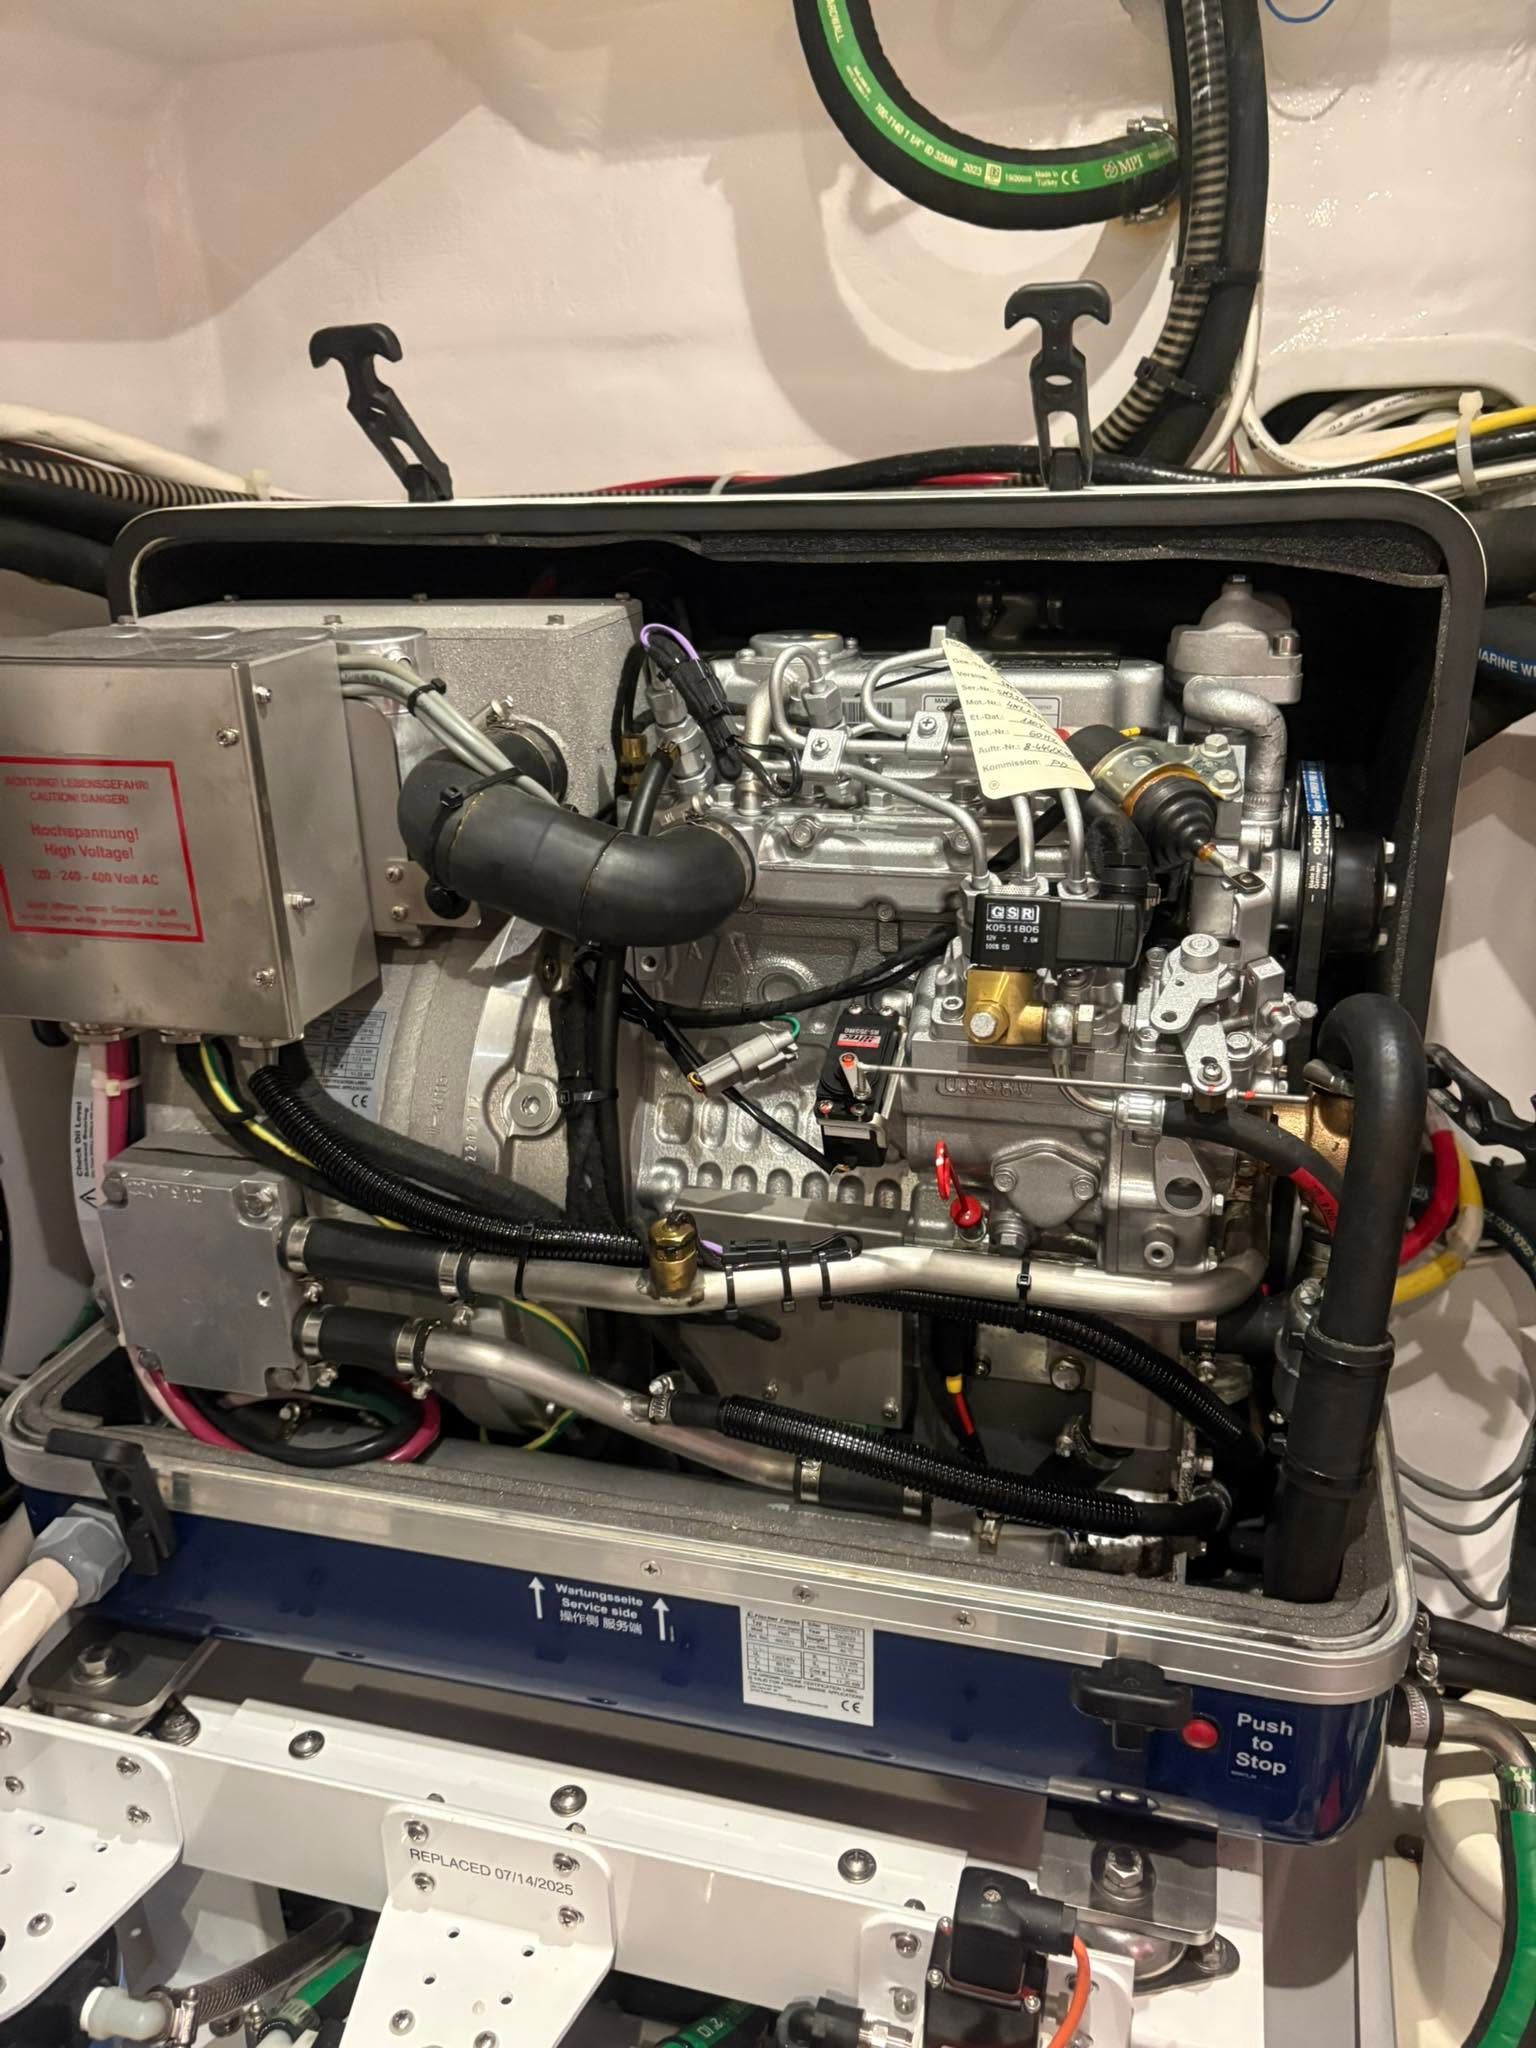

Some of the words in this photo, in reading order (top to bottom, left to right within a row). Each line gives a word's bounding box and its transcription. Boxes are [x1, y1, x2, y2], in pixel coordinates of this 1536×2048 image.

[1478, 648, 1519, 674] ARINE
[31, 824, 139, 843] Hochspannung!
[1312, 816, 1322, 855] optibel
[44, 844, 76, 859] High
[80, 846, 134, 862] Voltage!
[142, 875, 160, 885] AC
[990, 905, 1035, 920] GSR
[985, 924, 1040, 934] K0511806
[74, 1101, 82, 1128] Level
[74, 1129, 82, 1144] Oil
[74, 1146, 83, 1177] Check
[555, 1583, 643, 1607] Wartungsseite
[561, 1597, 608, 1614] Service
[611, 1607, 638, 1620] side
[841, 1700, 861, 1714] CE
[1237, 1712, 1294, 1737] Push
[1251, 1736, 1274, 1752] to
[1235, 1751, 1287, 1776] Stop
[409, 1848, 491, 1877] REPLACED
[494, 1868, 574, 1897] 07/14/2025
